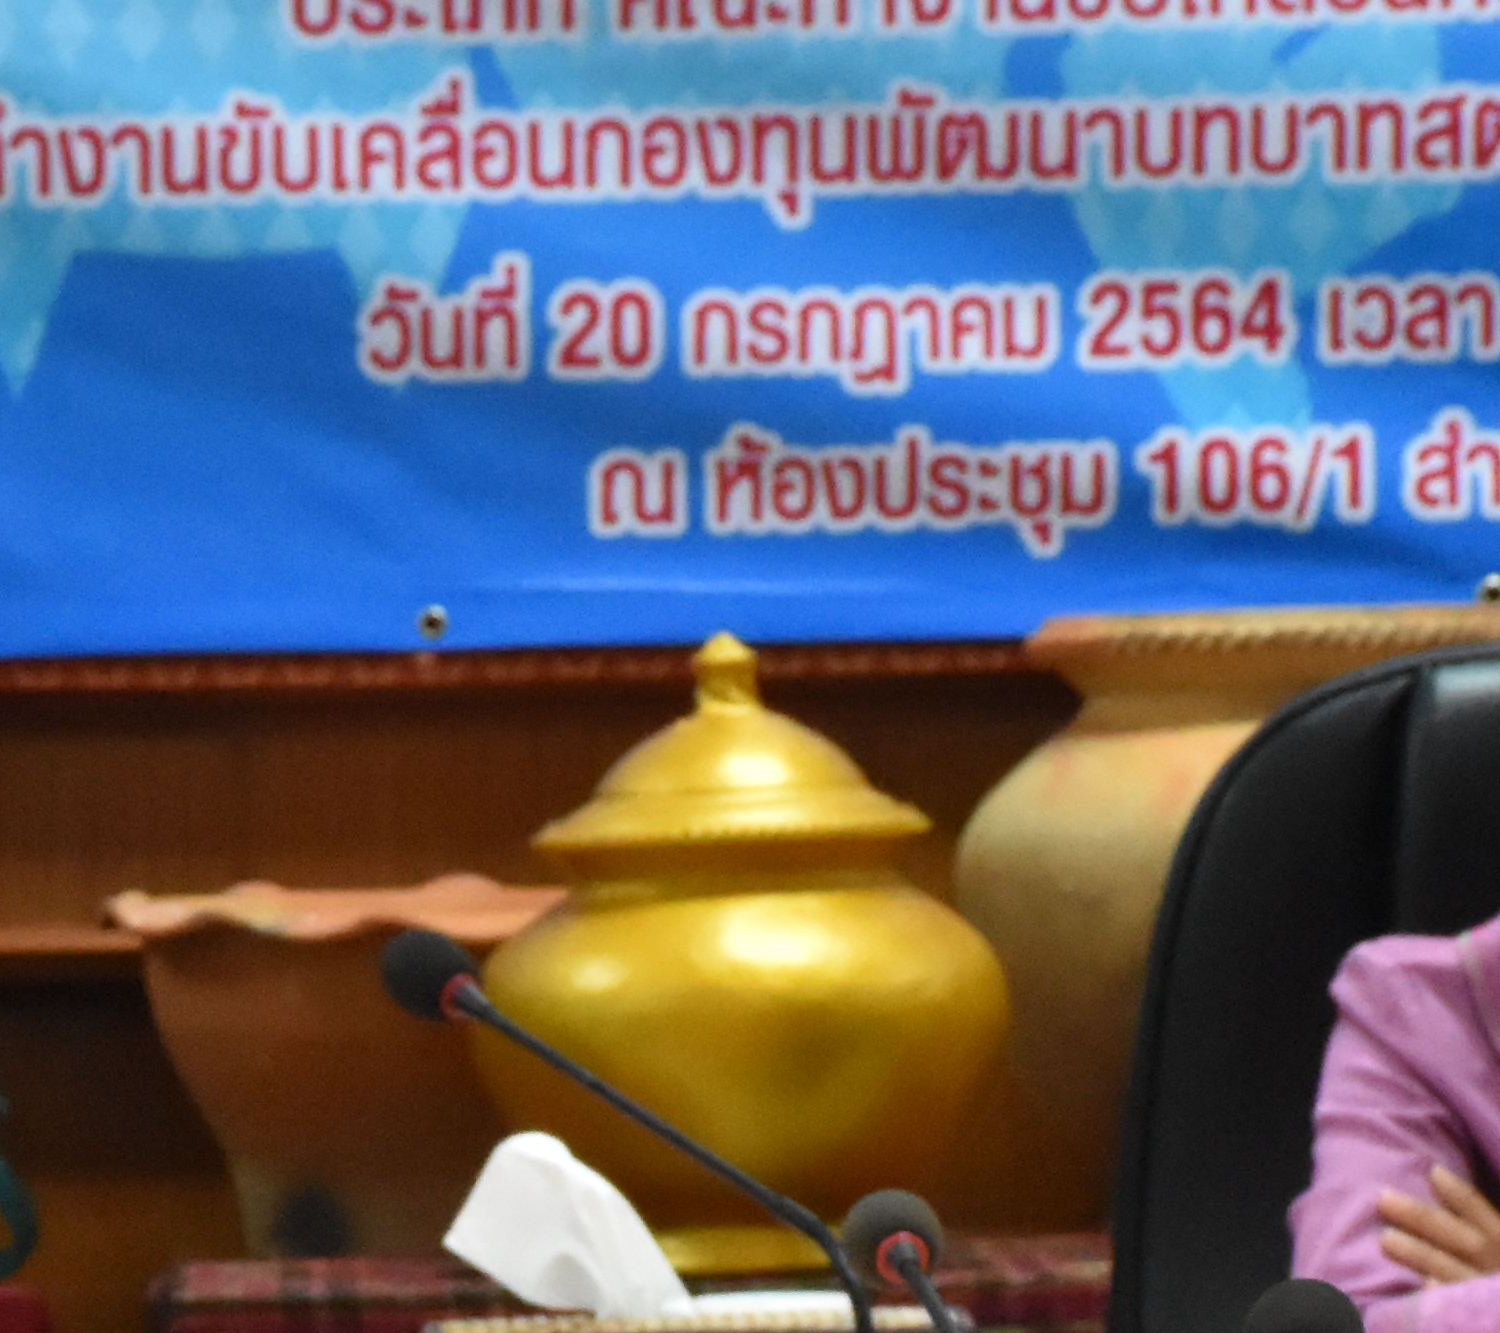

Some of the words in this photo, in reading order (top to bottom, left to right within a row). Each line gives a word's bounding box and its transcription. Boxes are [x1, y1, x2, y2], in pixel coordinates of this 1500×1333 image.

[366, 266, 520, 372] วันที่
[555, 290, 653, 370] 20
[691, 294, 1050, 385] กรกฎาคม
[1087, 278, 1286, 358] 2564
[1327, 284, 1495, 356] เวลา
[599, 458, 682, 526] ณ
[713, 432, 1107, 546] ห้องประชุม
[1148, 434, 1364, 526] 106/1
